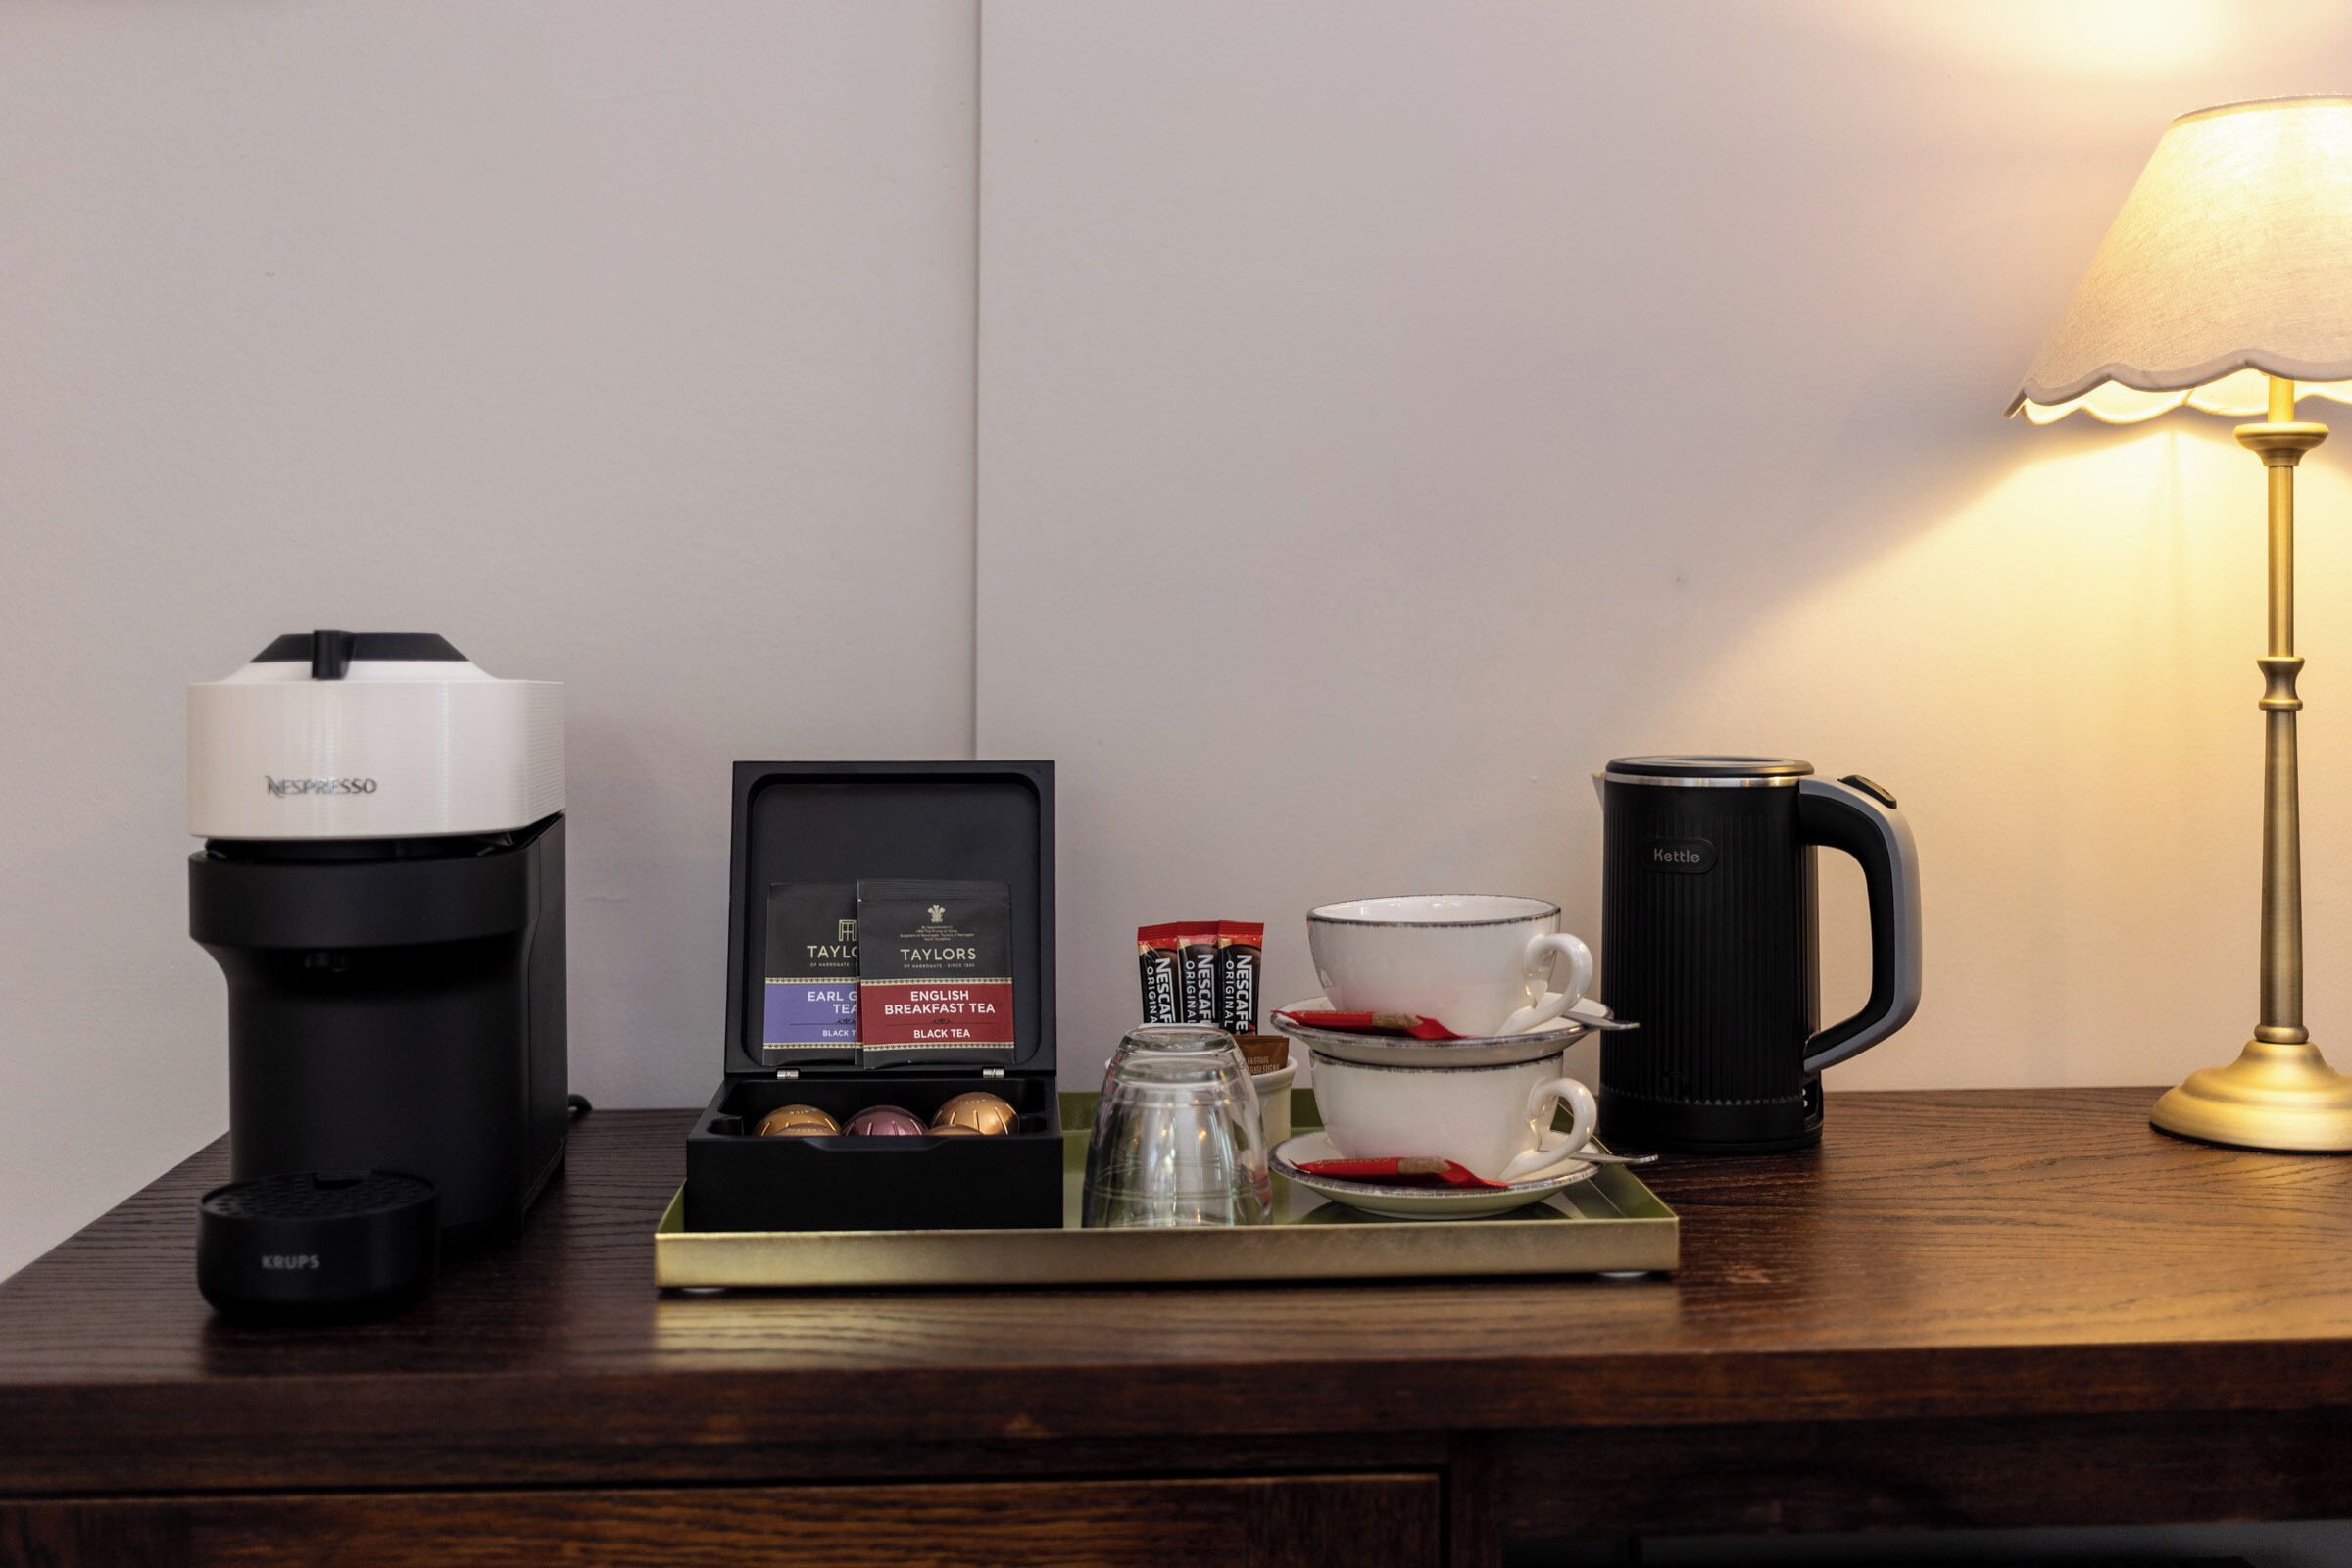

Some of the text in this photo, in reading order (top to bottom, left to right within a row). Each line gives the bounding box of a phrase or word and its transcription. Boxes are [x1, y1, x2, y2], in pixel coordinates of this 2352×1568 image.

[265, 775, 377, 798] NESPRESSO
[1653, 848, 1701, 863] Kettle
[806, 945, 858, 958] TAYLO
[900, 948, 977, 961] TAYLORS
[808, 991, 844, 1002] EARL
[910, 990, 969, 1002] ENGLISH
[1146, 965, 1159, 1024] ORIGINA
[1155, 957, 1176, 1024] NESCAF
[1223, 960, 1235, 1028] ORIGINAL
[884, 1003, 996, 1015] BREAKFAST TEA
[913, 1028, 971, 1039] BLACK TEA
[261, 1254, 321, 1270] KRUPS
